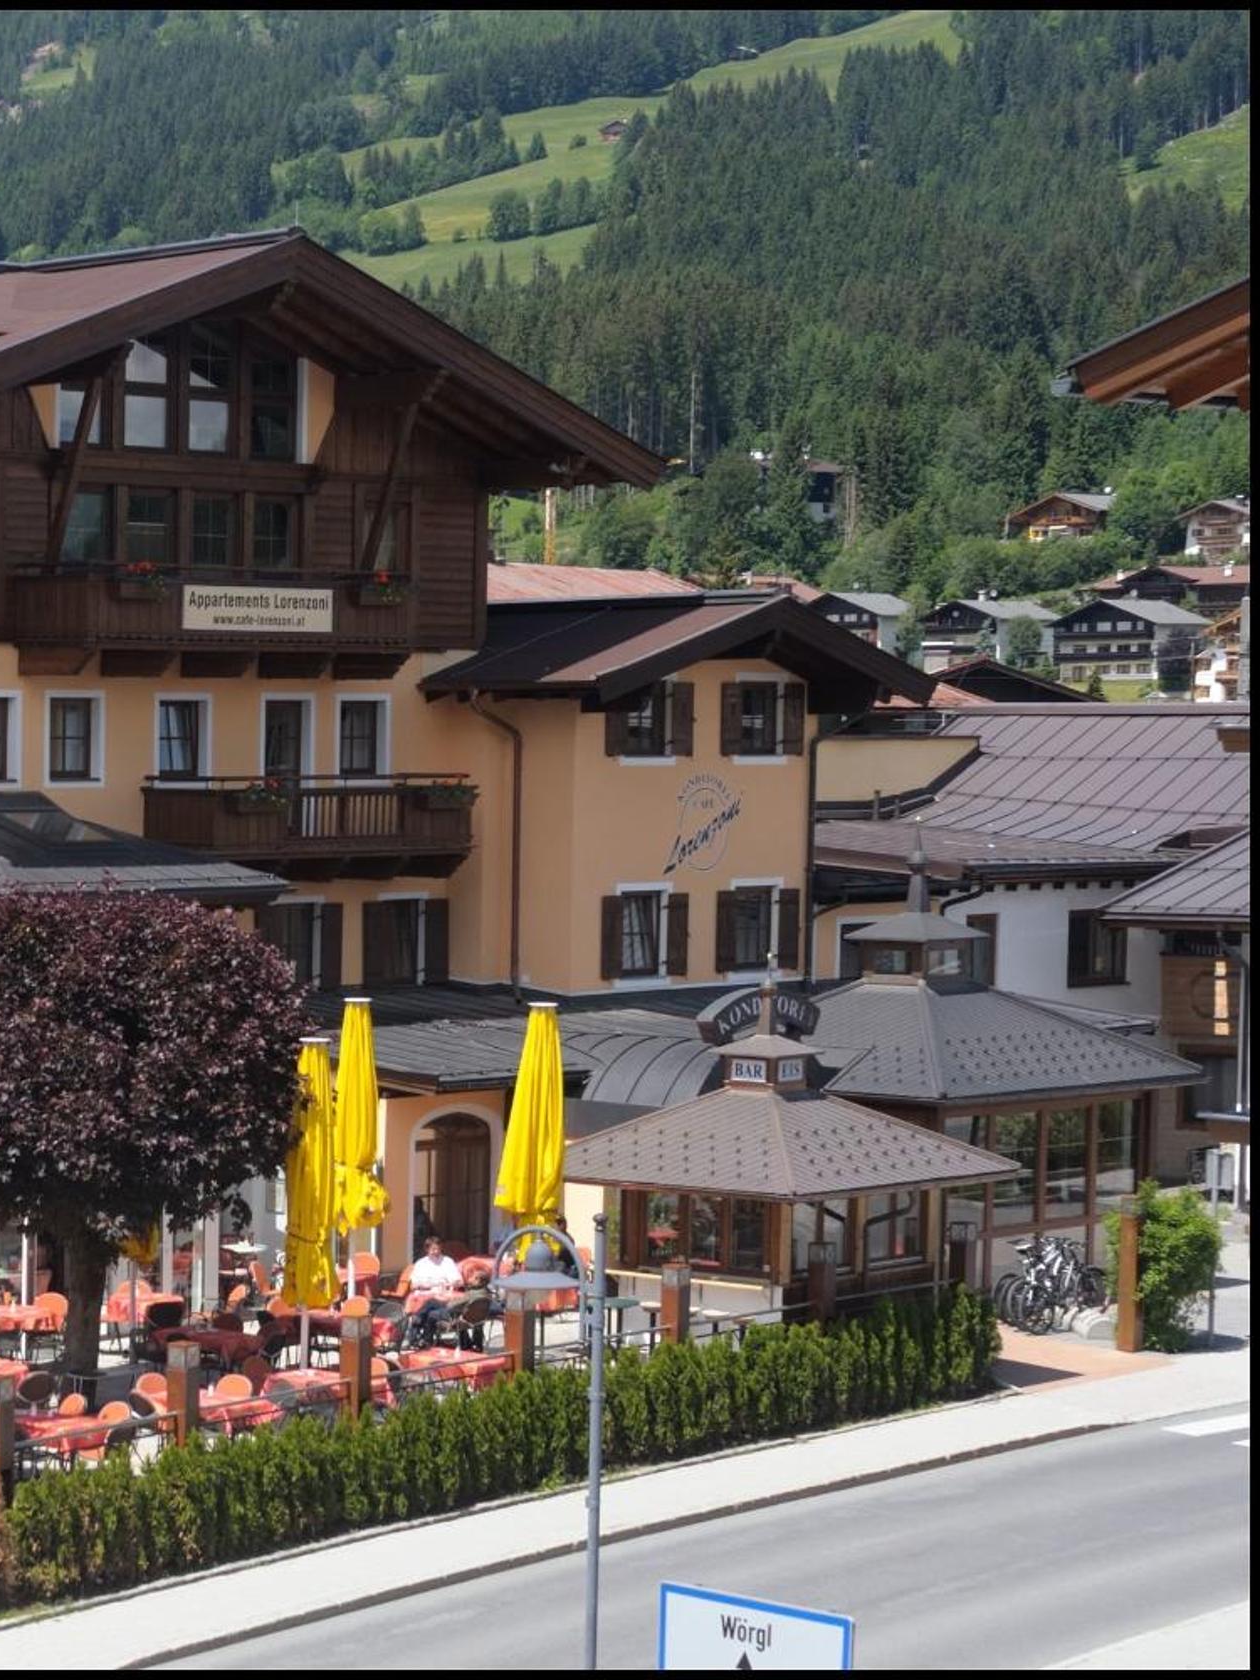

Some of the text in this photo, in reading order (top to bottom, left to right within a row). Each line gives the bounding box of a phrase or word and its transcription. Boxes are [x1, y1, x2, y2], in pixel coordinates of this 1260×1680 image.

[189, 591, 329, 610] Appartements Lorenzoni
[735, 1062, 763, 1078] BAR
[720, 1614, 772, 1652] Wörgl
